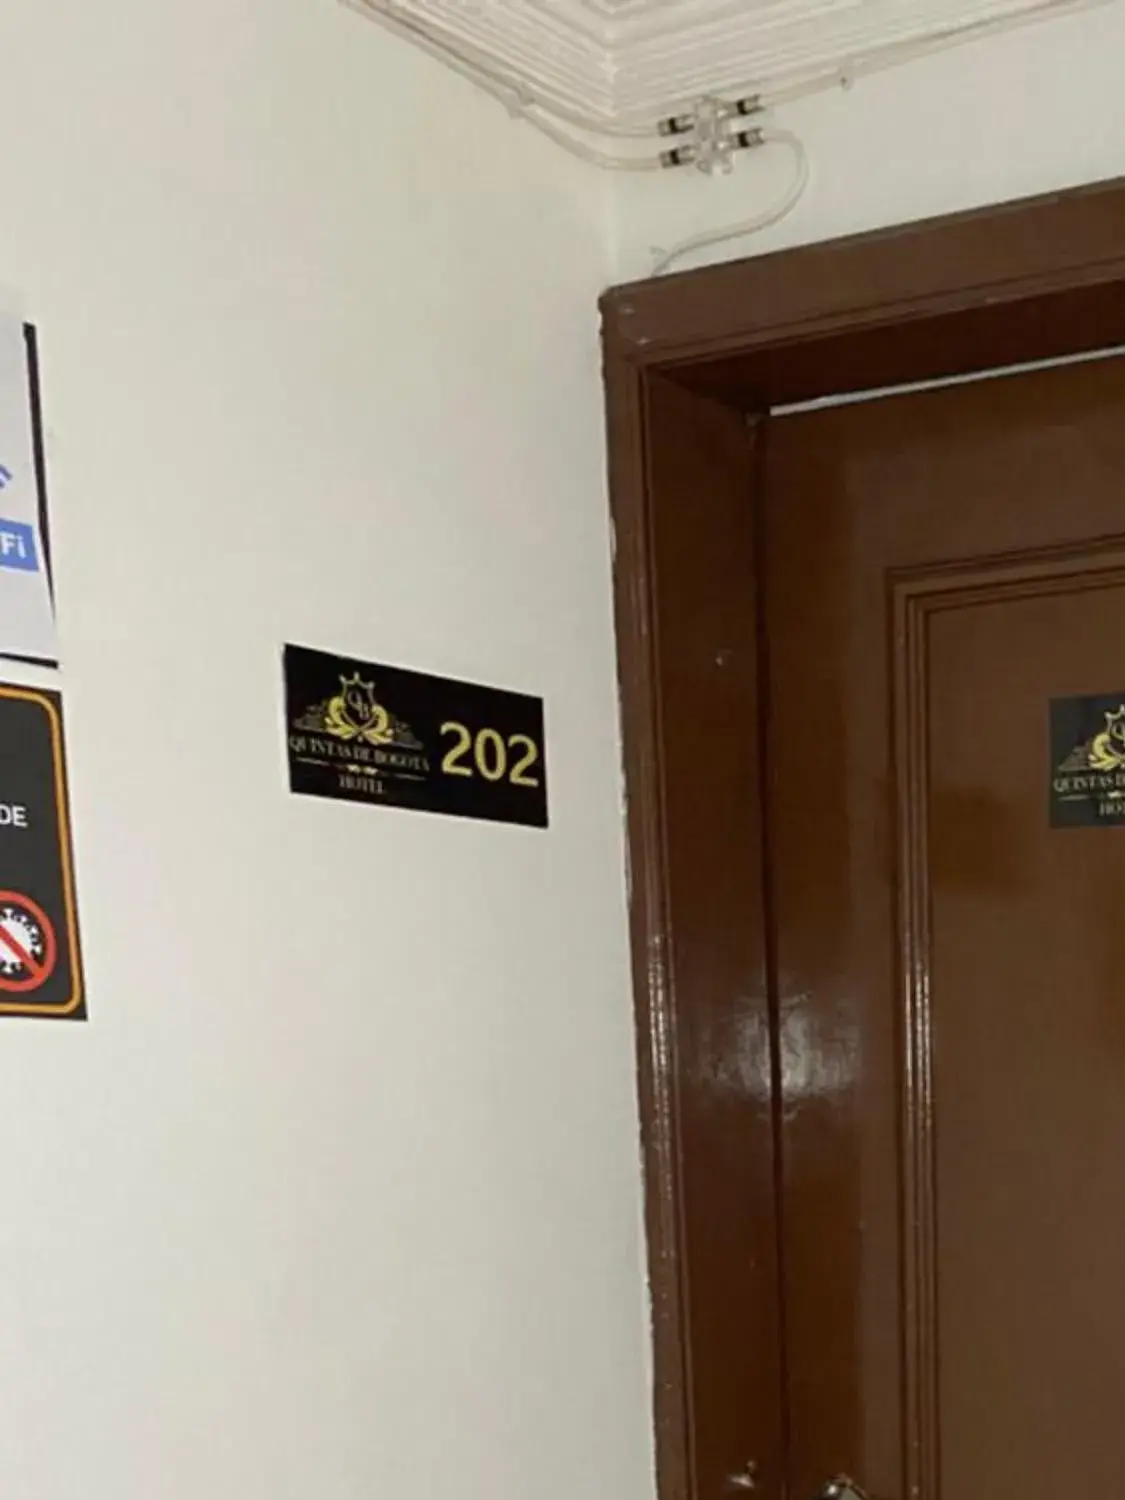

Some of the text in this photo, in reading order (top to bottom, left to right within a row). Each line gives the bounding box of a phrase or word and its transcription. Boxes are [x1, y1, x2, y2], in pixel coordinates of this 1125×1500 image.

[440, 721, 540, 788] 202
[339, 773, 384, 795] HOTEL
[0, 803, 28, 828] DE
